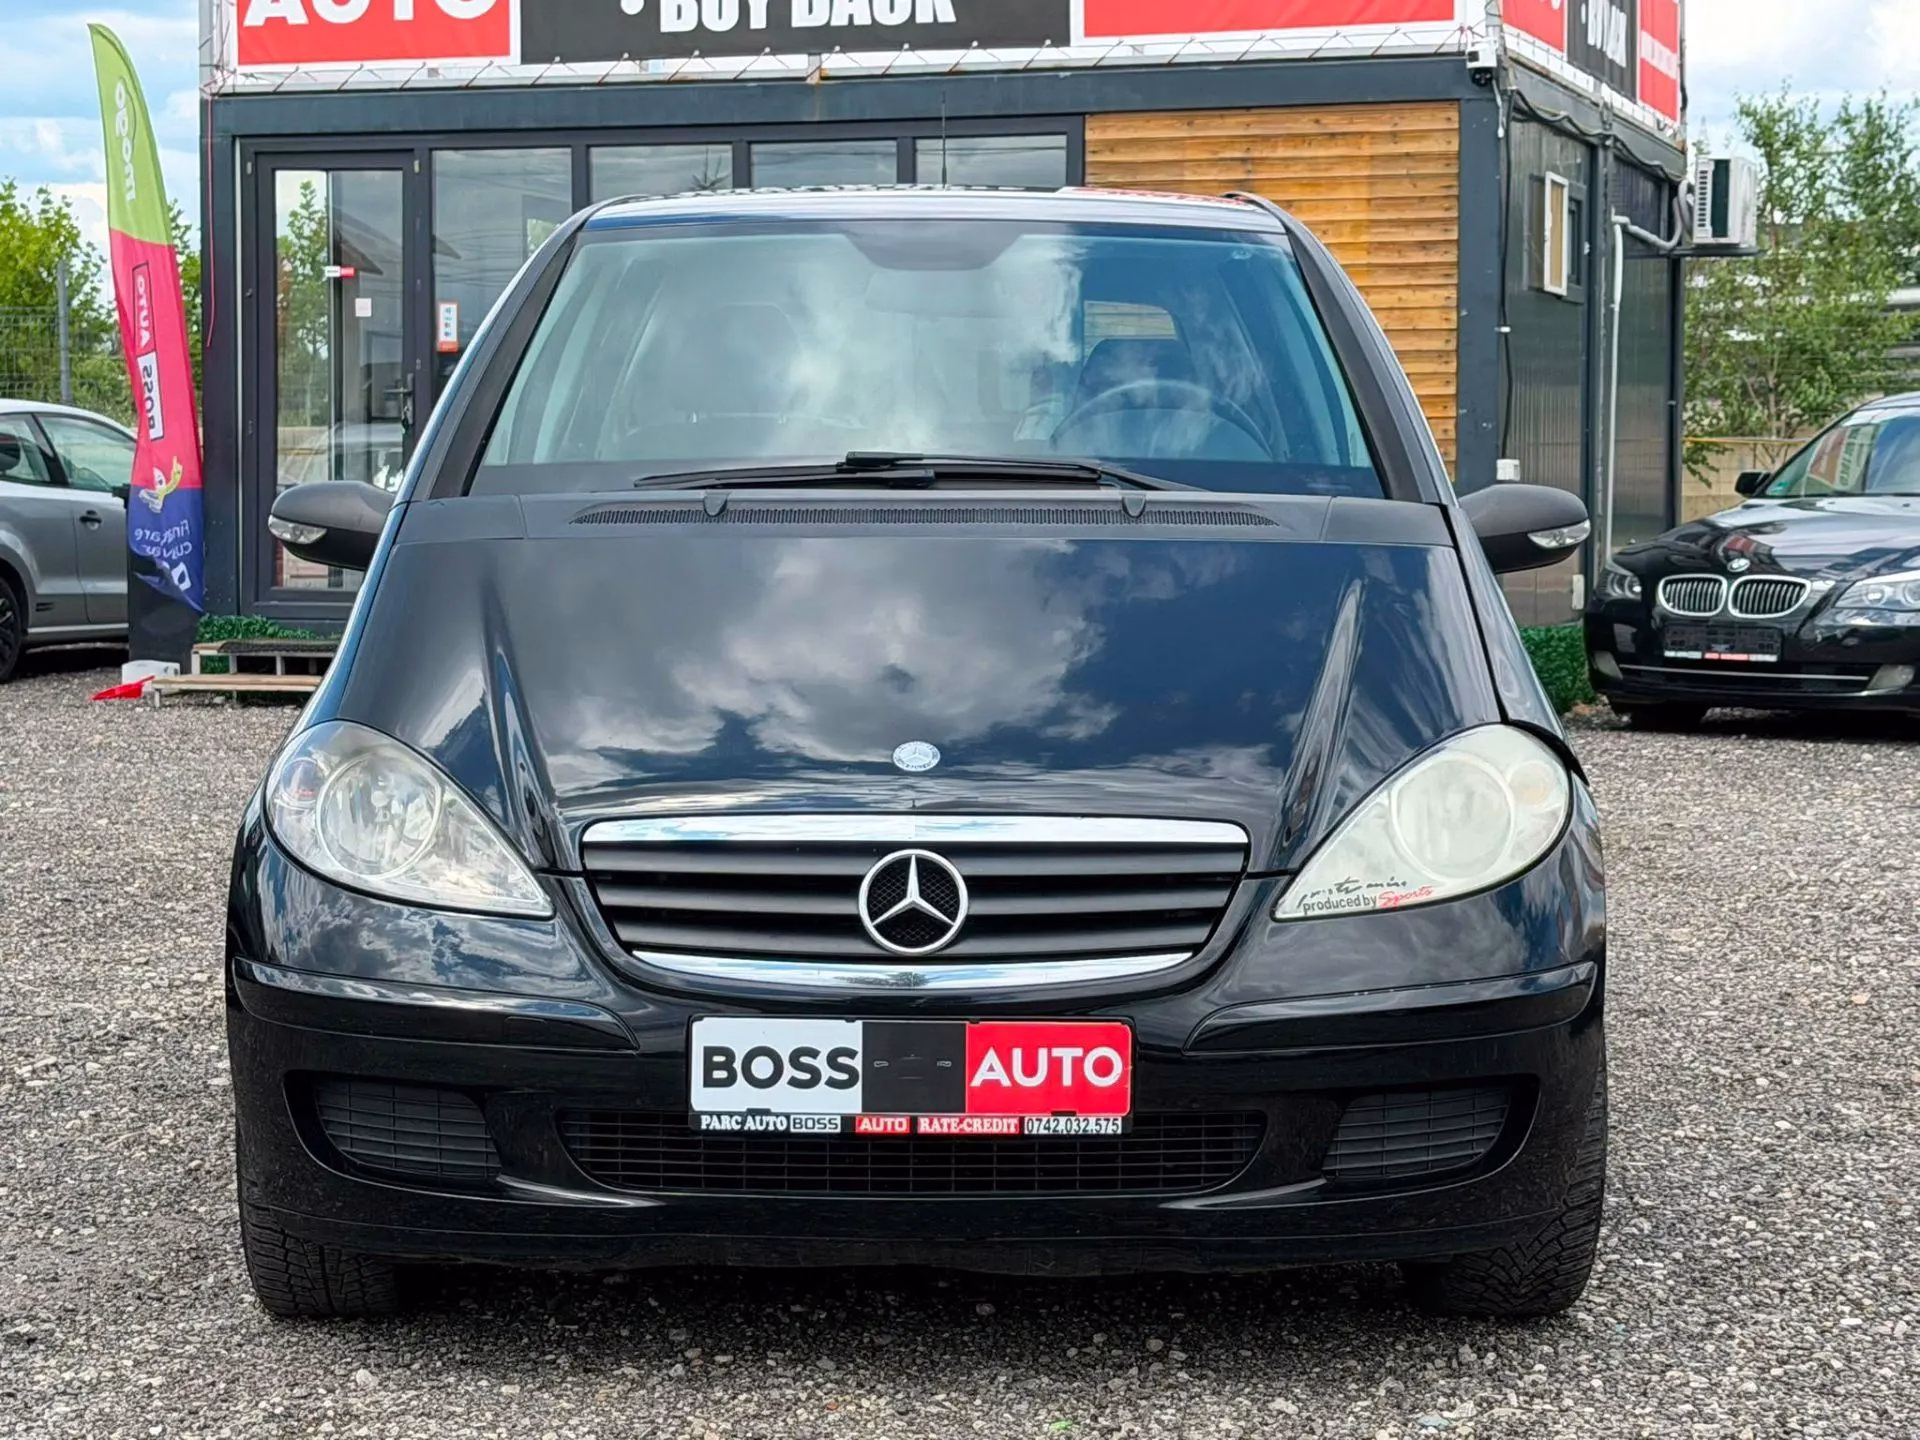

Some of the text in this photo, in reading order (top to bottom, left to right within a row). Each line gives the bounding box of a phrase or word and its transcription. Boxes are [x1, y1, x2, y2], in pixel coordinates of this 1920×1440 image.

[1303, 894, 1361, 916] produced
[1362, 893, 1378, 910] by
[1378, 886, 1435, 912] Sports
[702, 1045, 860, 1090] BOSS
[970, 1047, 1123, 1088] AUTO
[701, 1114, 742, 1131] PARC
[744, 1115, 788, 1131] AUTO
[792, 1117, 839, 1131] BOSS
[859, 1116, 908, 1132] AUTO
[919, 1117, 1019, 1133] RATE-CREDIT
